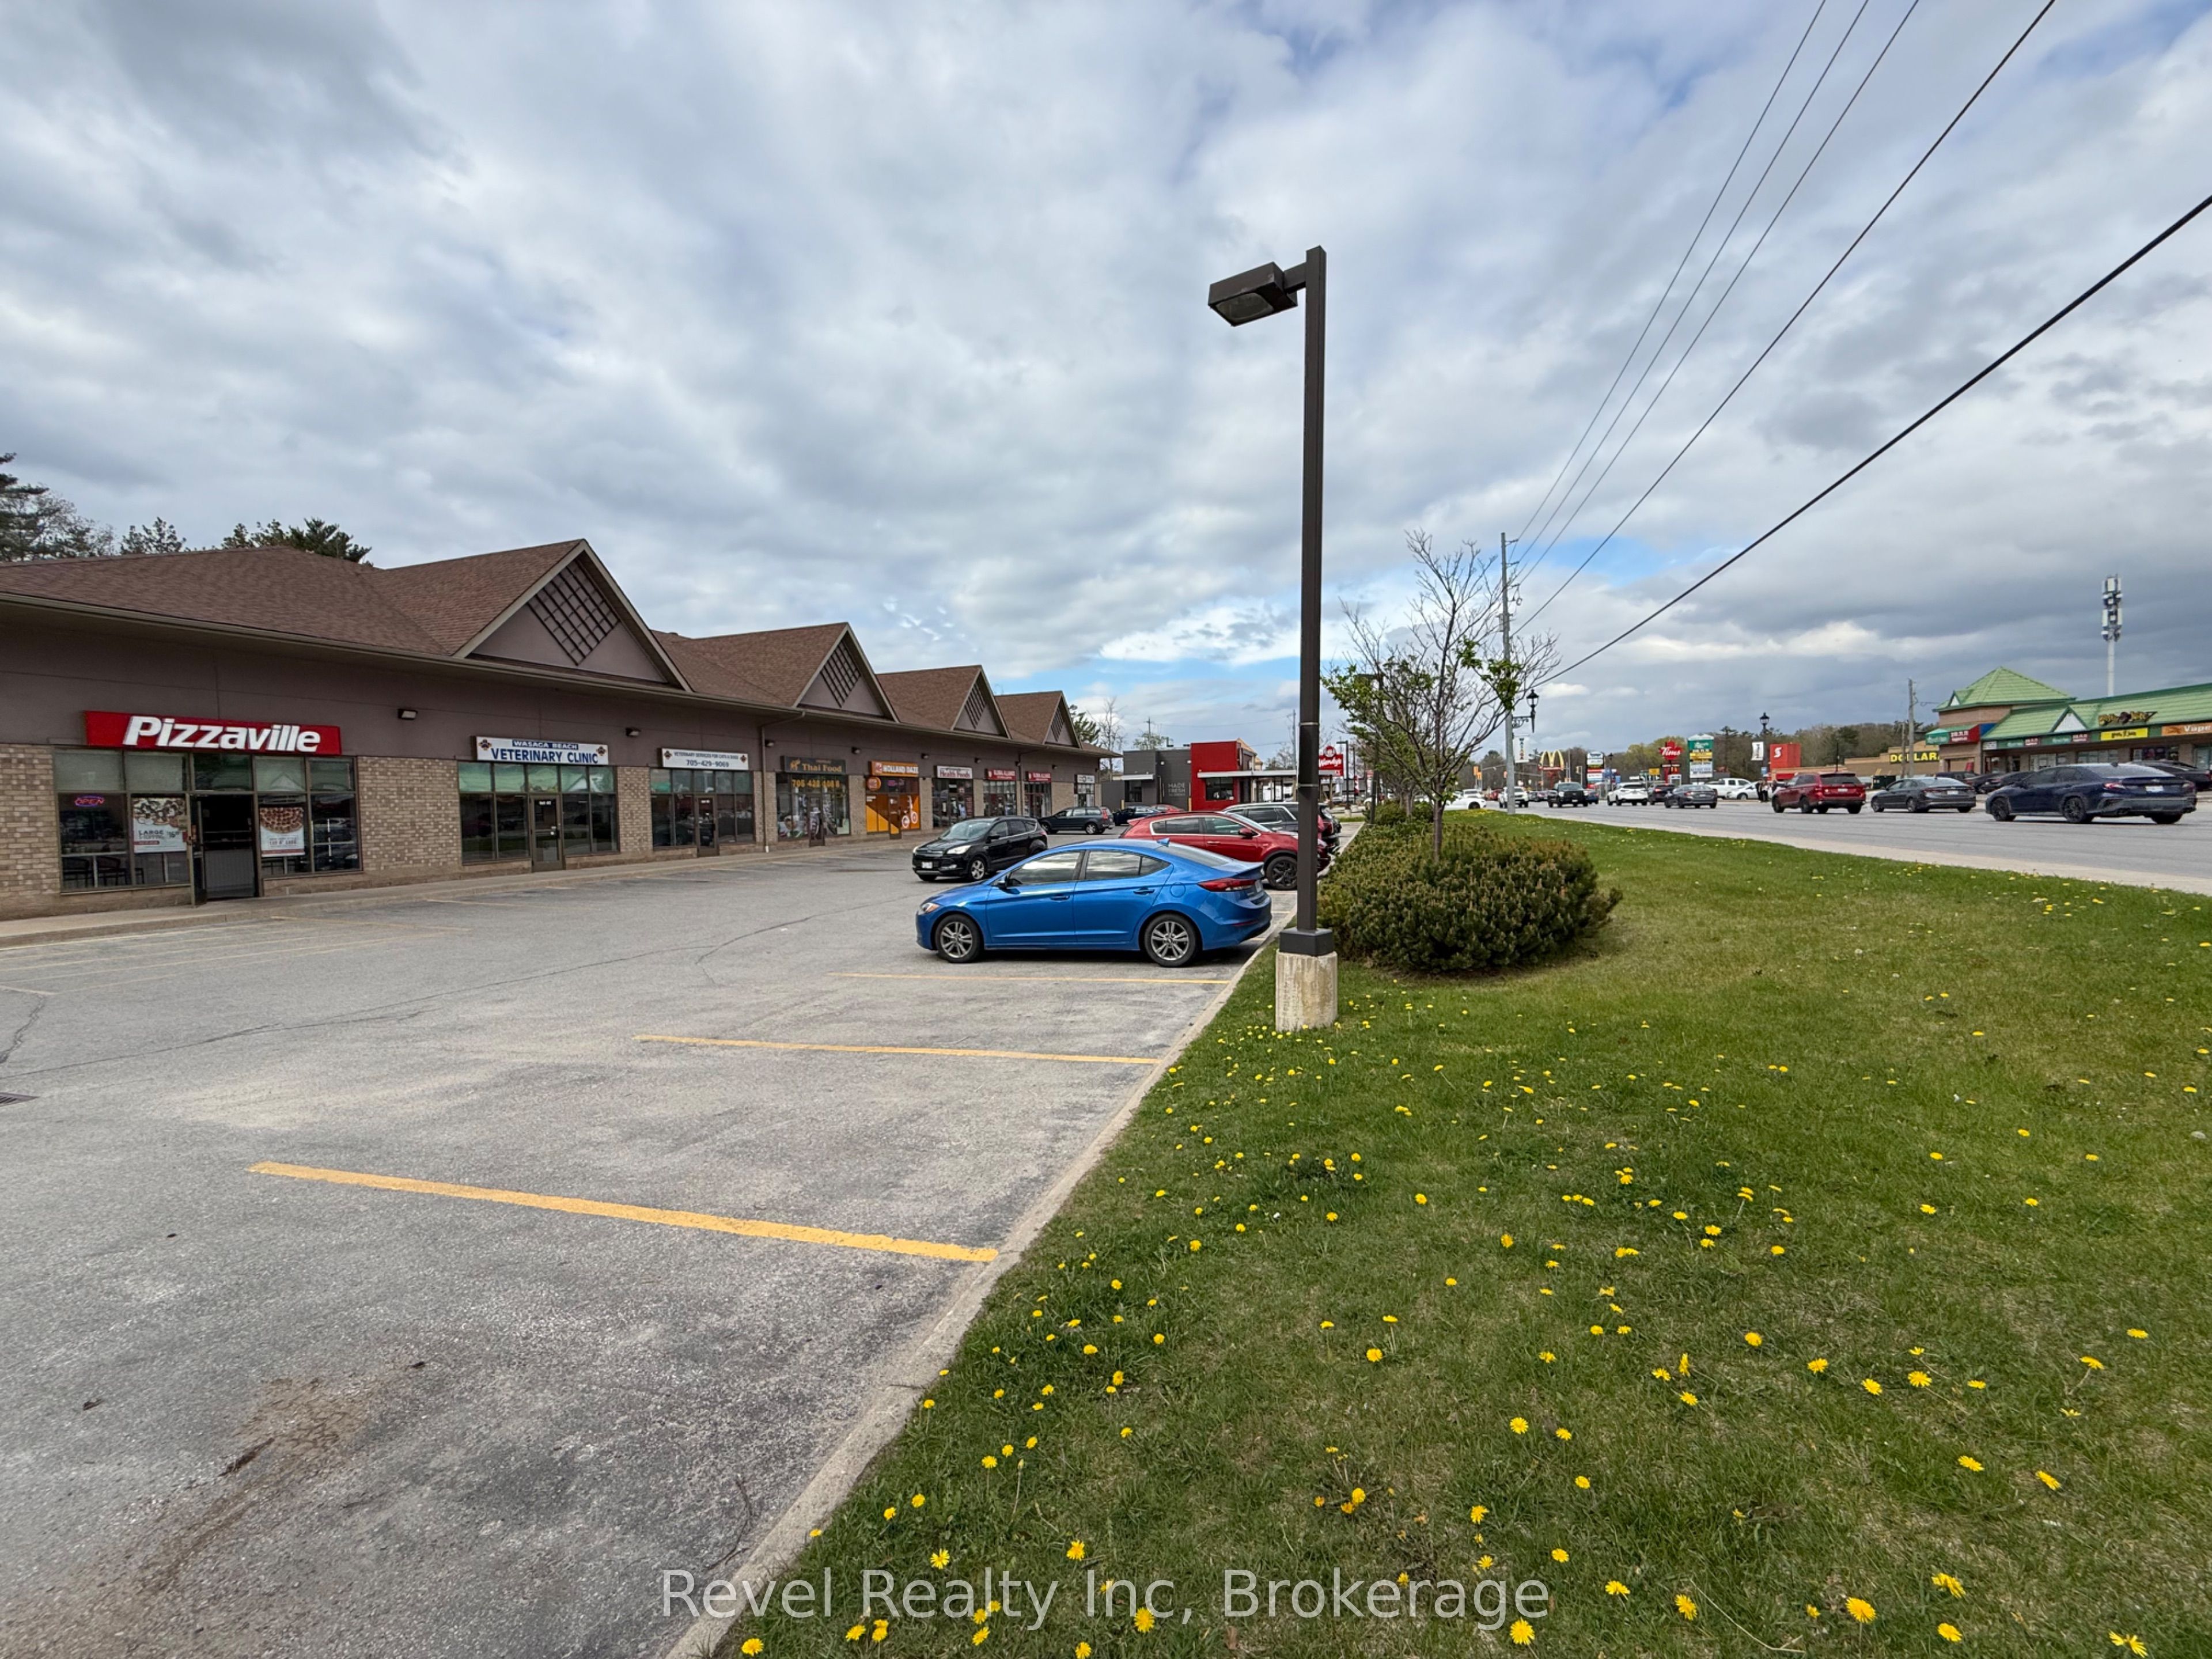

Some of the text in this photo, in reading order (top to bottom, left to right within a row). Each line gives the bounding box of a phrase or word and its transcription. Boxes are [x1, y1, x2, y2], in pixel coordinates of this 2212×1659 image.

[123, 715, 321, 752] Pizzaville
[491, 748, 599, 764] VETERINARY CLINIC
[1661, 747, 1681, 756] Tims
[802, 763, 821, 771] Thai
[75, 797, 104, 806] OPEN
